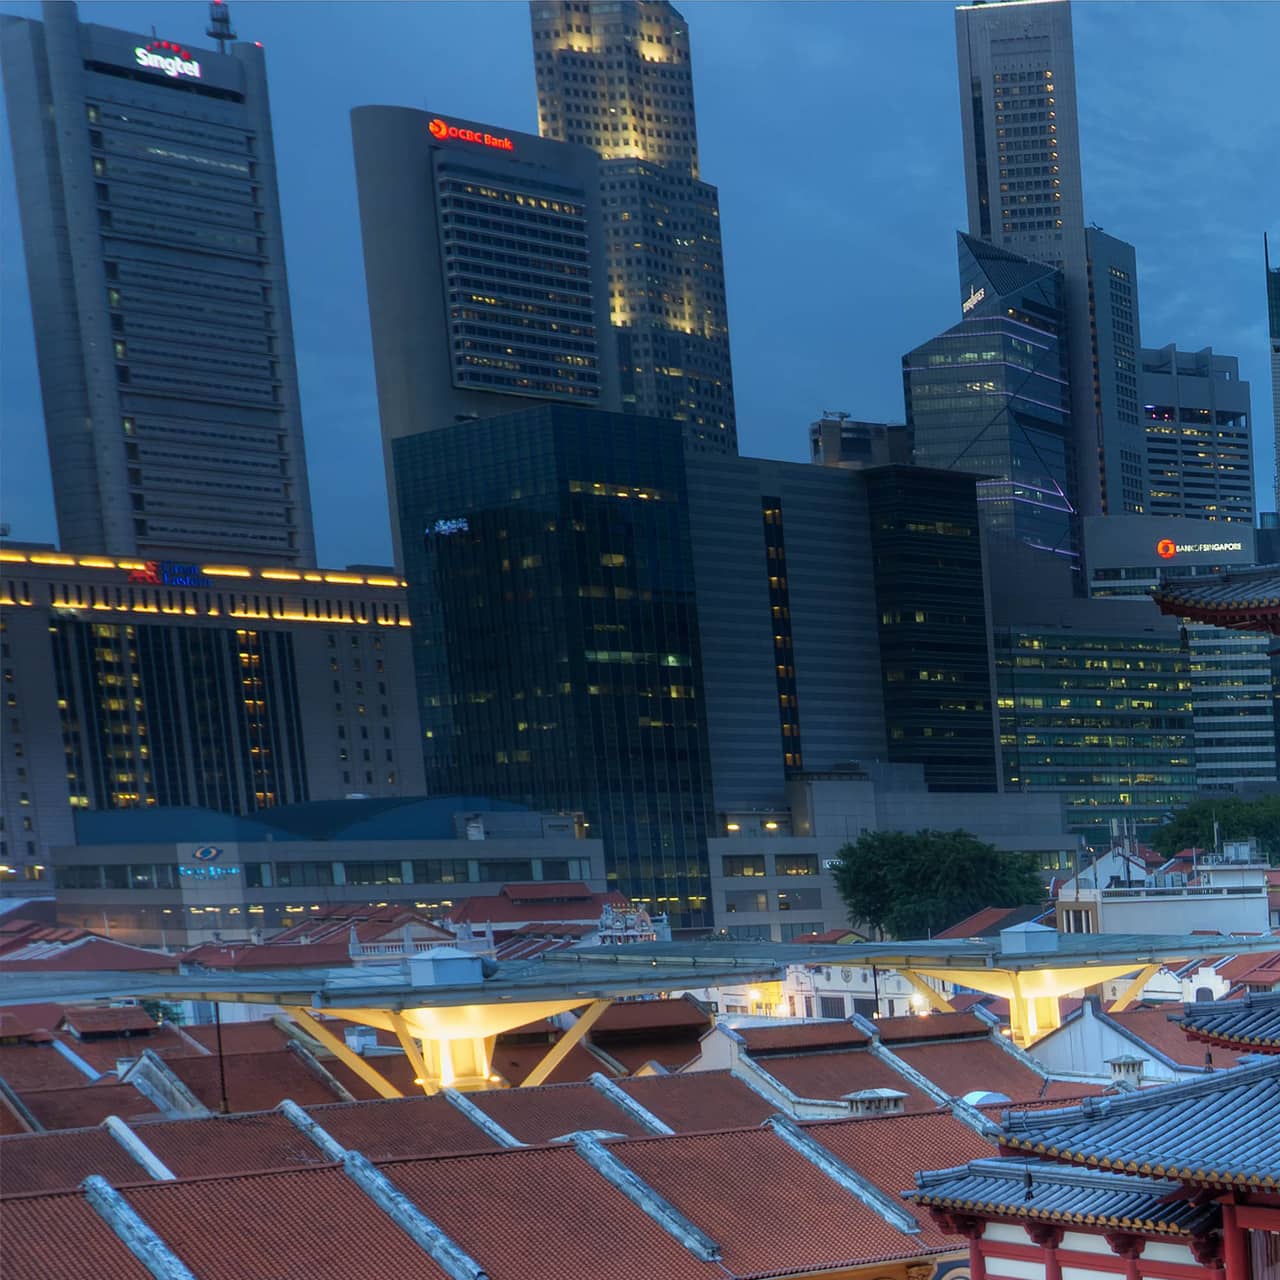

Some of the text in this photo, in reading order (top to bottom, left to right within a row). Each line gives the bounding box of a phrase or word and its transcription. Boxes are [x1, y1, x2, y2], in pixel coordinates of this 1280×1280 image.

[134, 47, 202, 78] Singtel
[448, 126, 514, 152] OCBC Bank
